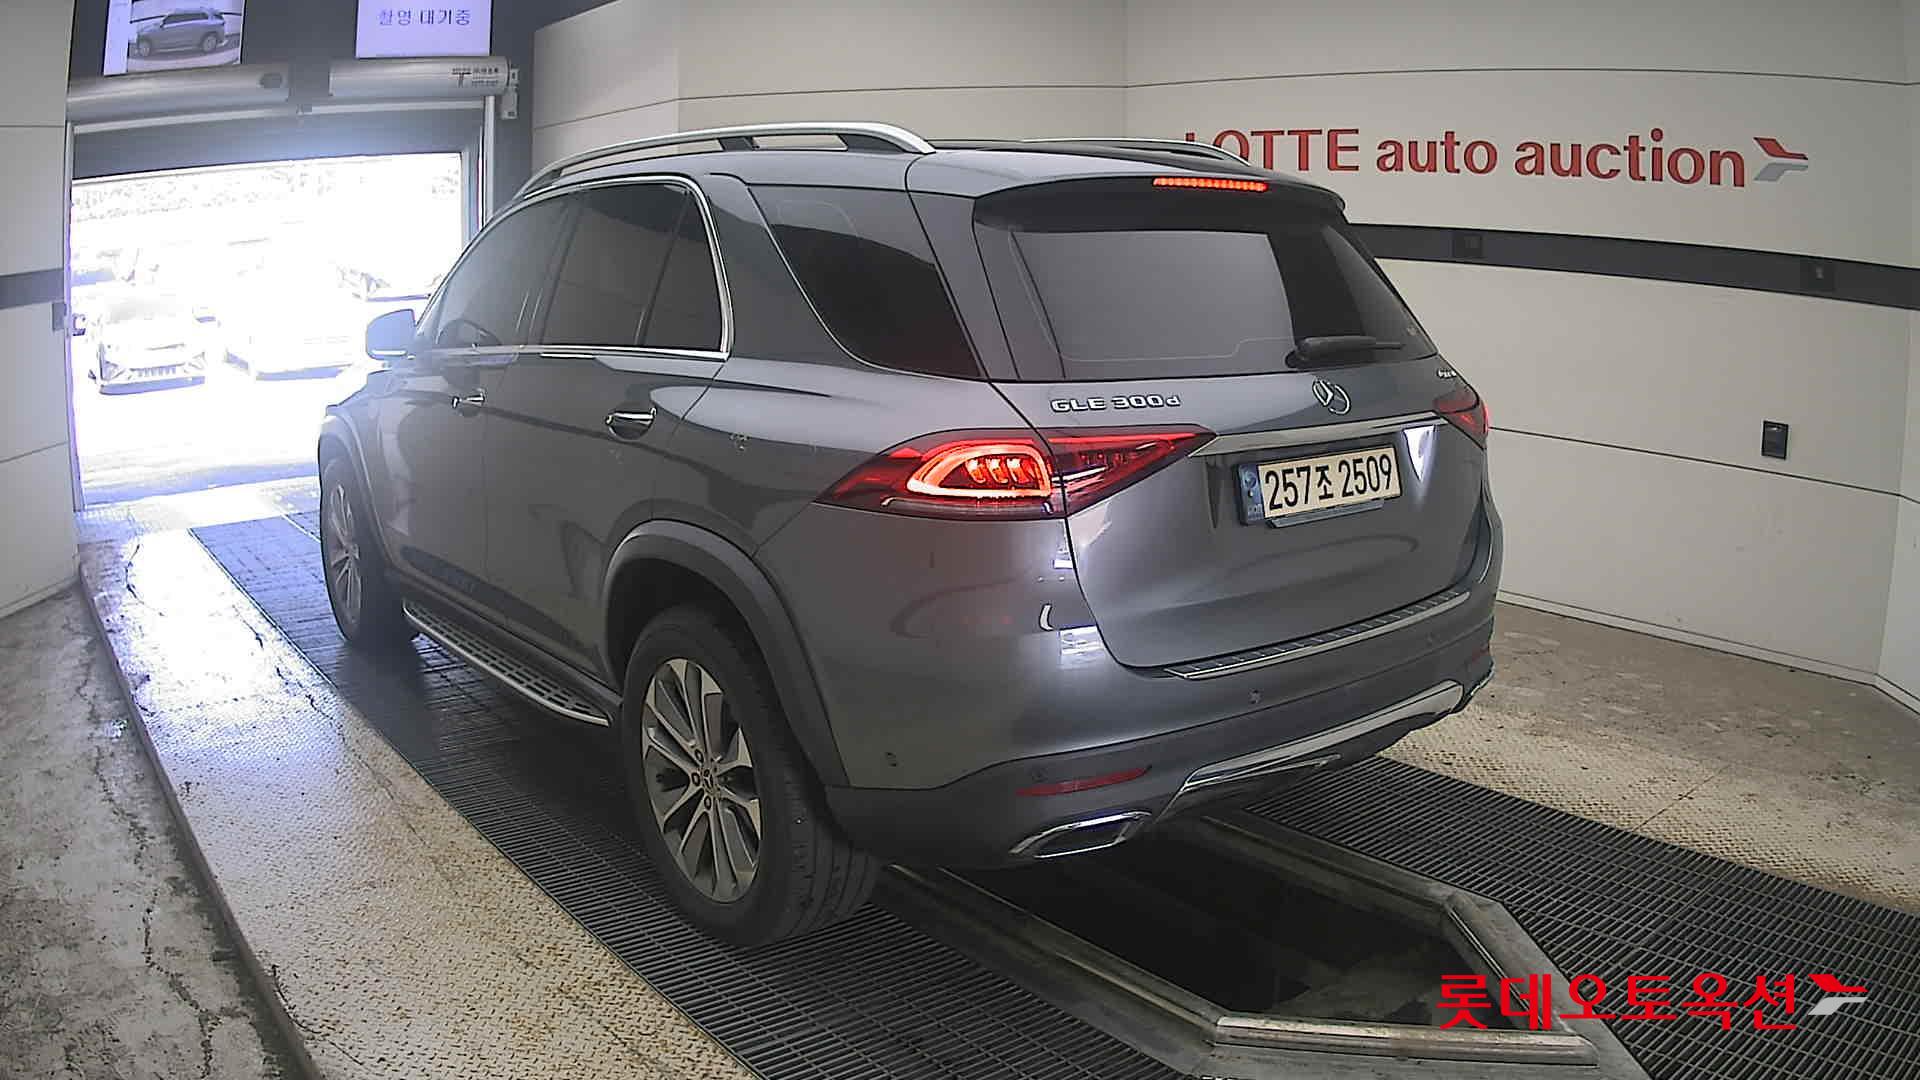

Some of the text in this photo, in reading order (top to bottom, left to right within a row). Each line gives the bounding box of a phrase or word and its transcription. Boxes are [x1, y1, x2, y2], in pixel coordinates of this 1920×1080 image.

[420, 9, 470, 26] 대기중
[1185, 127, 1746, 188] OTTE auto auction
[1050, 393, 1181, 413] GLE 300d
[1264, 453, 1392, 511] 257조 2509
